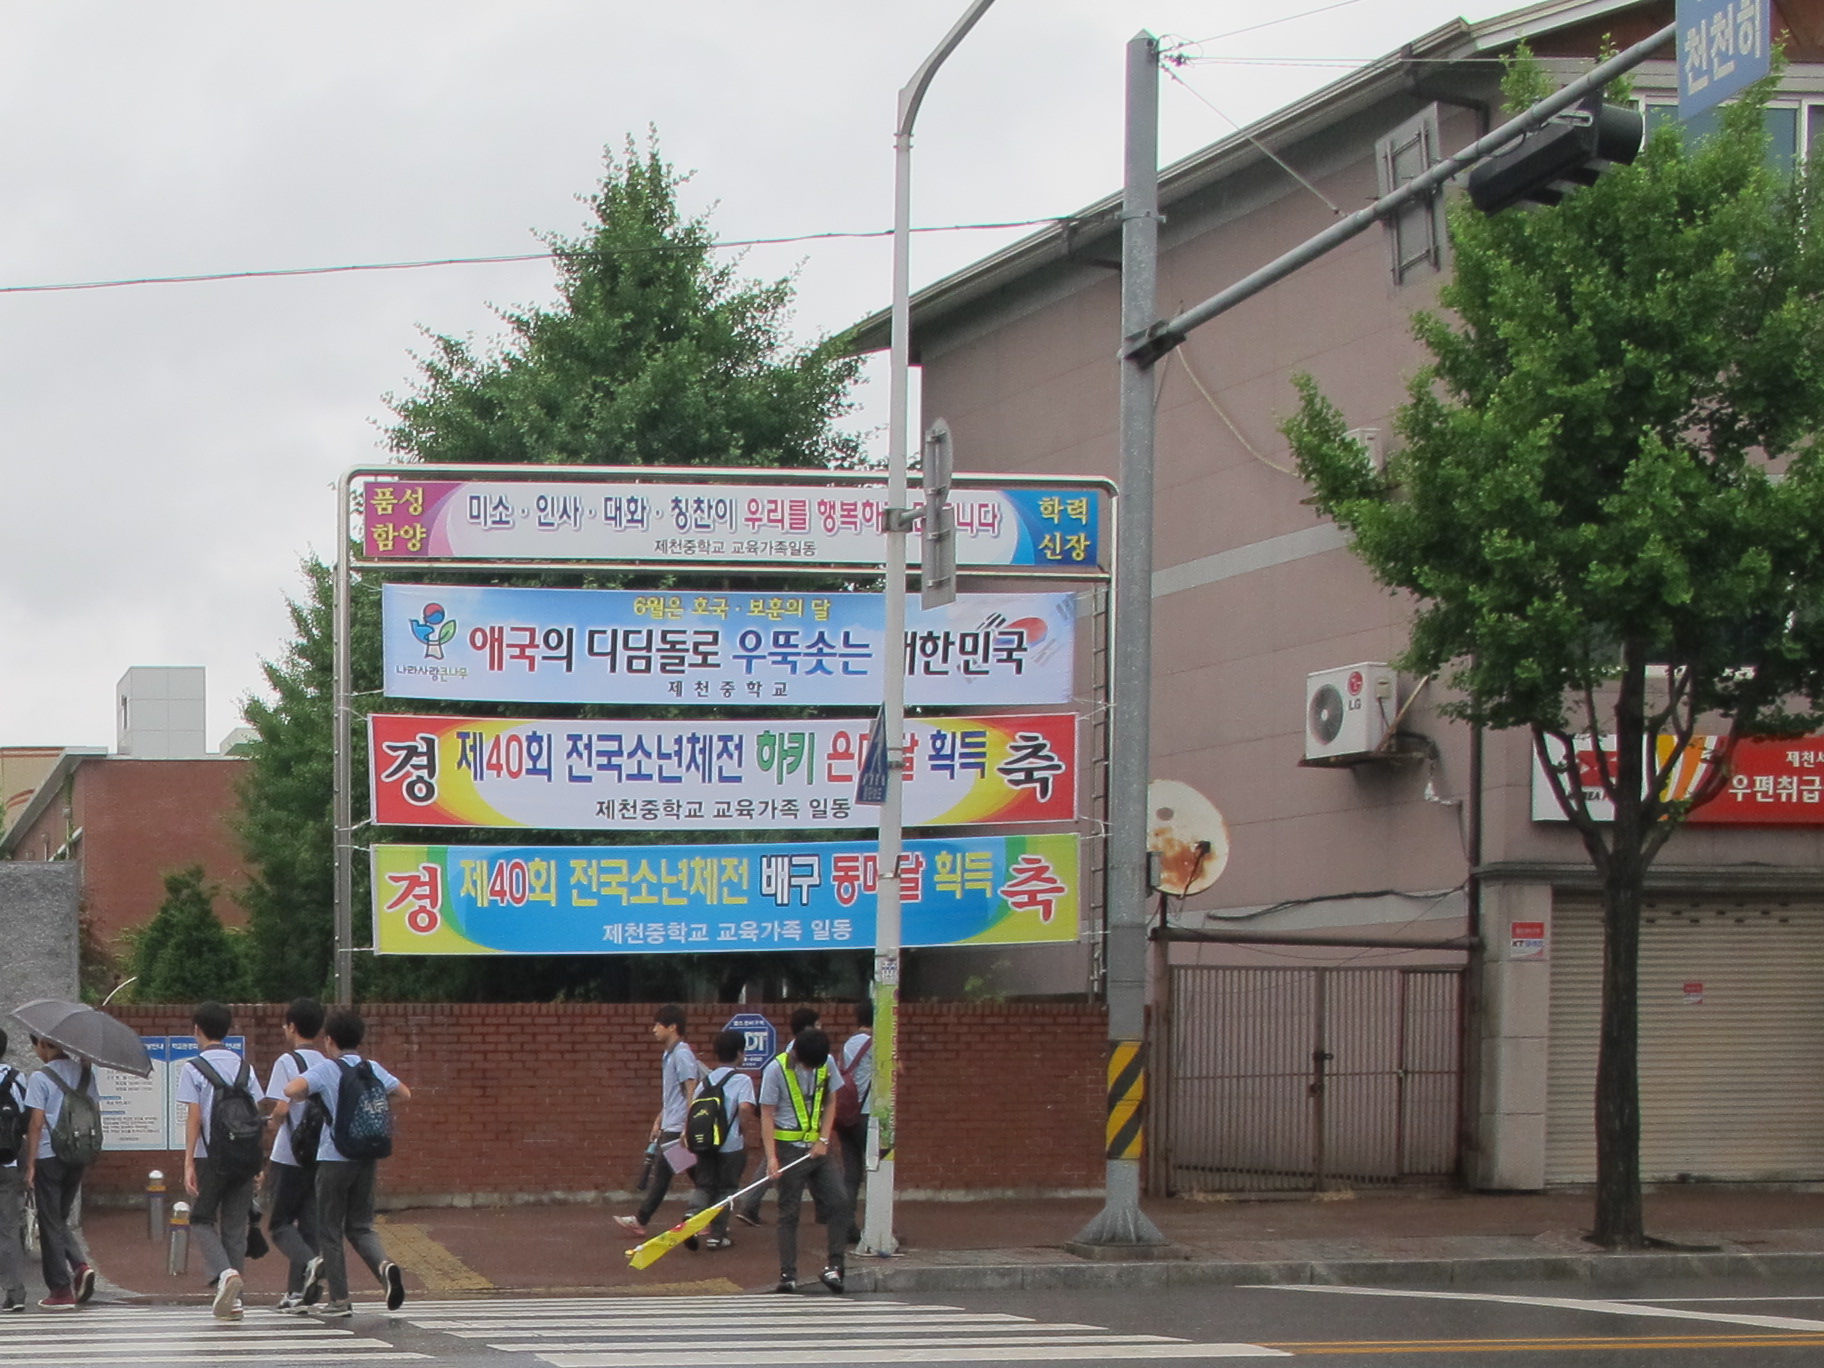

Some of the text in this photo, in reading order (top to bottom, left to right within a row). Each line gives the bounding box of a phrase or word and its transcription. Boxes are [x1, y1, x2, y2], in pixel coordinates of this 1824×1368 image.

[370, 487, 424, 515] 품성
[469, 494, 514, 527] 미소
[536, 494, 579, 528] 인사
[604, 495, 647, 528] 대화
[671, 496, 736, 530] 칭찬이
[743, 498, 811, 531] 우리를
[1037, 497, 1088, 524] 학력
[370, 523, 426, 552] 함양
[654, 539, 725, 555] 제천중학교
[1038, 532, 1090, 560] 신장
[633, 597, 831, 621] 6월은 호국 보훈의 달
[469, 625, 573, 673] 애국의
[587, 627, 721, 675] 디딤돌로
[732, 629, 872, 676] 우뚝솟는
[396, 665, 468, 682] 나라사랑큰나무
[1349, 699, 1361, 711] LG
[381, 733, 439, 806] 경
[456, 730, 553, 782] 제40회
[565, 731, 744, 784] 전국소년체전
[756, 730, 815, 785] 하키
[928, 730, 987, 780] 획득
[996, 732, 1066, 803] 축
[596, 798, 851, 820] 제천중학교 교육가족 일동
[460, 858, 556, 907] 제40회
[570, 856, 748, 907] 전국소년체전
[760, 854, 822, 907] 배구
[934, 851, 993, 899] 획득
[999, 854, 1067, 923] 축
[385, 863, 441, 936] 경
[602, 919, 852, 944] 제천중학교 교육가족 일동
